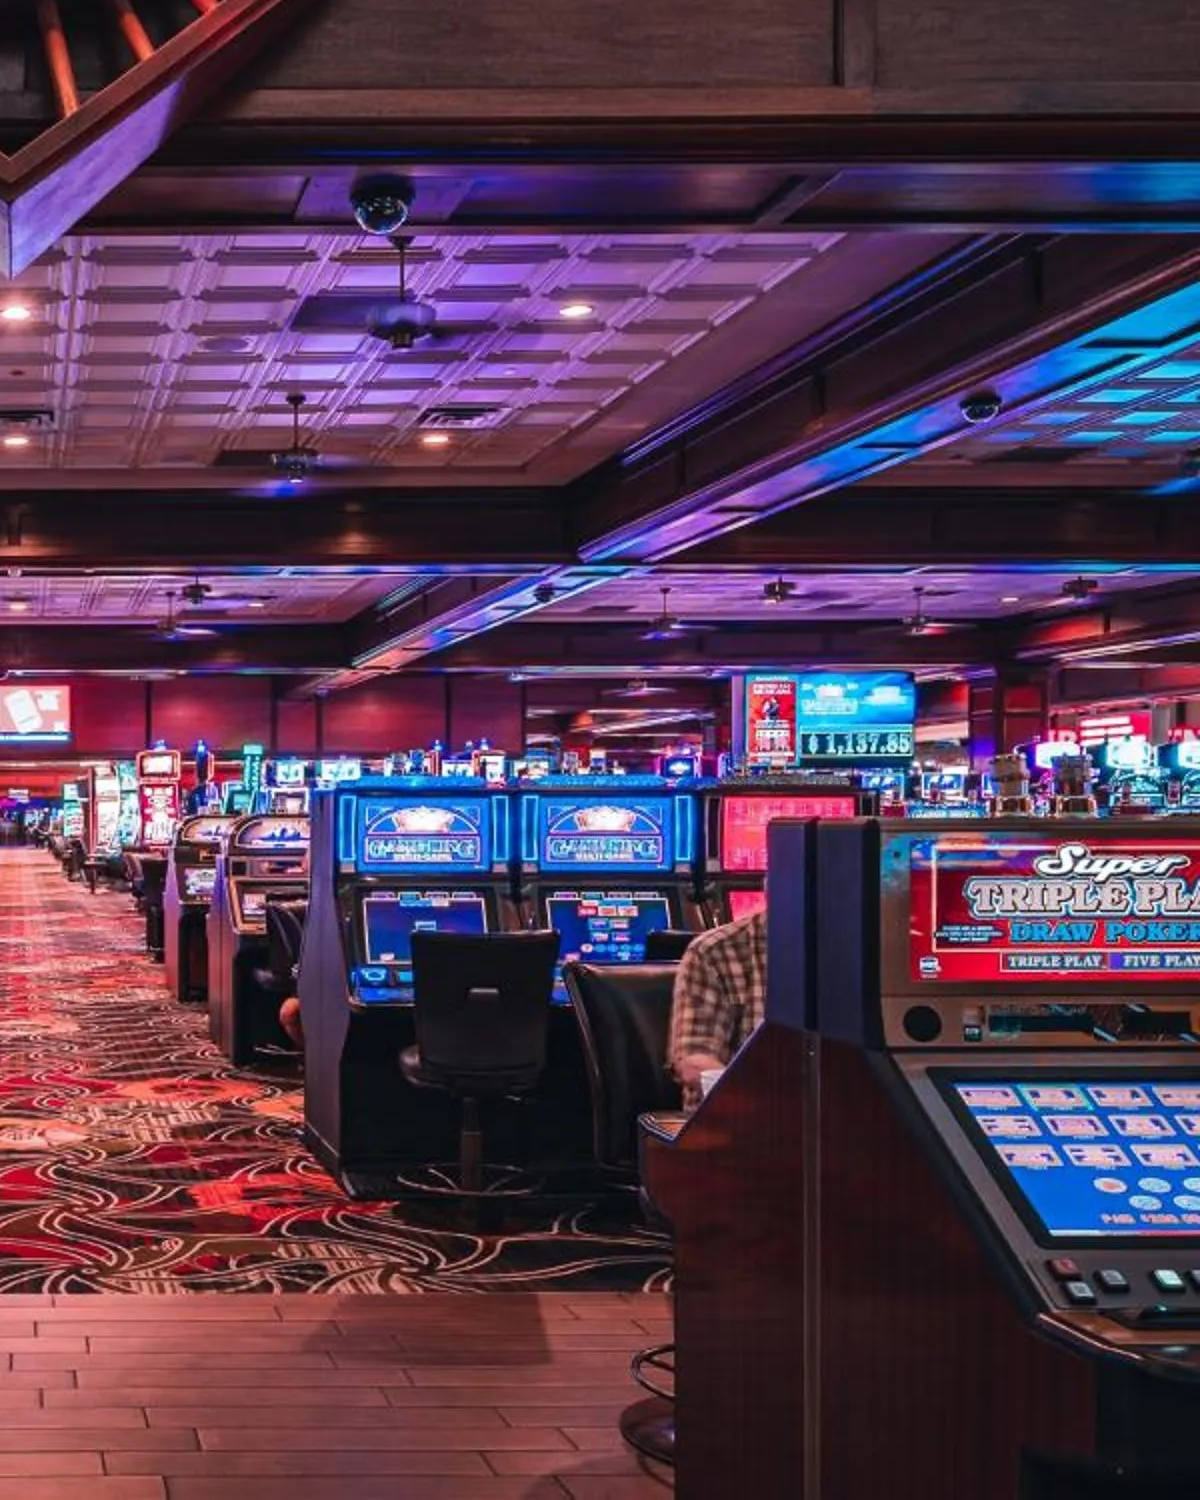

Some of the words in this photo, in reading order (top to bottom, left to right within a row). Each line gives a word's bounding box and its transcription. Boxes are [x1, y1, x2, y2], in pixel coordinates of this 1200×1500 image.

[1034, 843, 1189, 881] Super
[968, 879, 1130, 913] TRIPLE
[1009, 920, 1096, 943] DRAW
[1008, 954, 1062, 968] TRIPLE
[1063, 954, 1103, 968] PLAY
[1123, 954, 1161, 968] FIVE
[1165, 954, 1200, 968] PLAY
